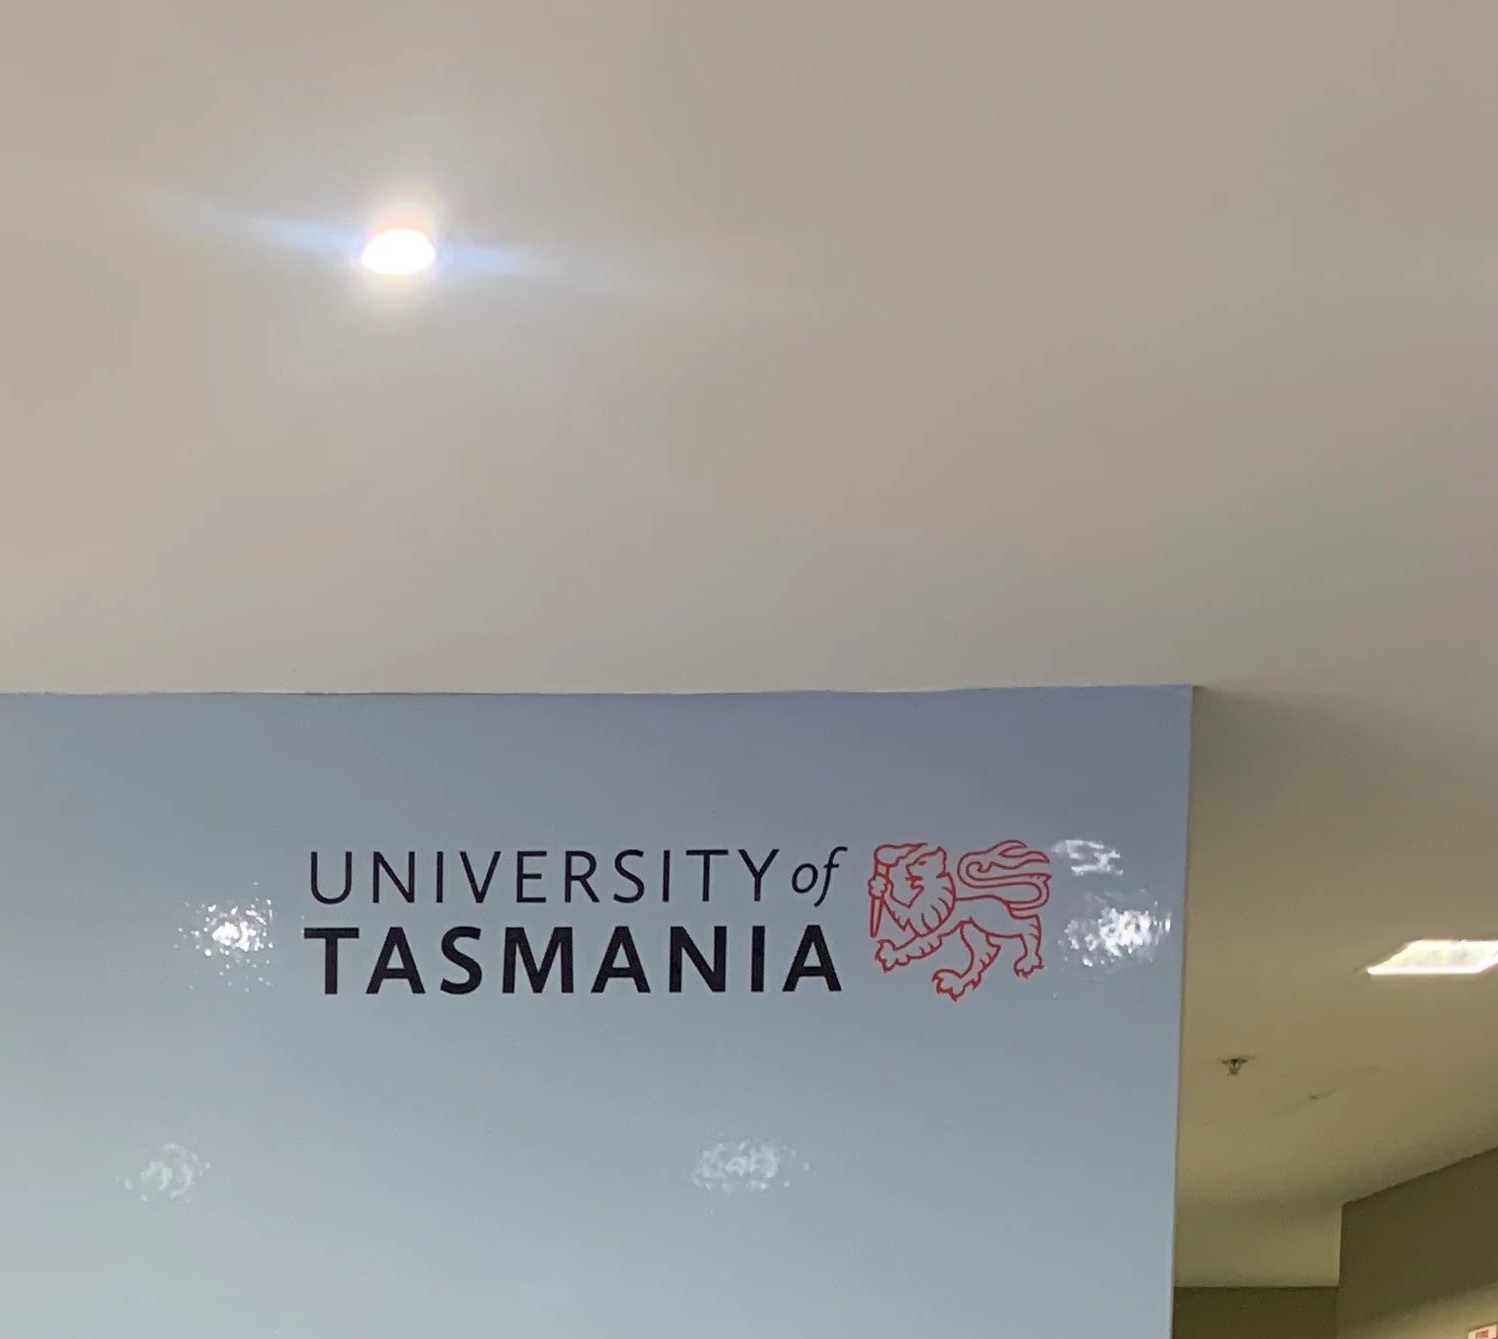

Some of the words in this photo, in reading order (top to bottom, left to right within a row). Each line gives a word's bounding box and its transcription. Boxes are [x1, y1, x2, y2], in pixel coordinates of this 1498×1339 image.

[308, 848, 781, 905] UNIVERSITY
[791, 846, 848, 908] of
[304, 924, 843, 995] TASMANIA
